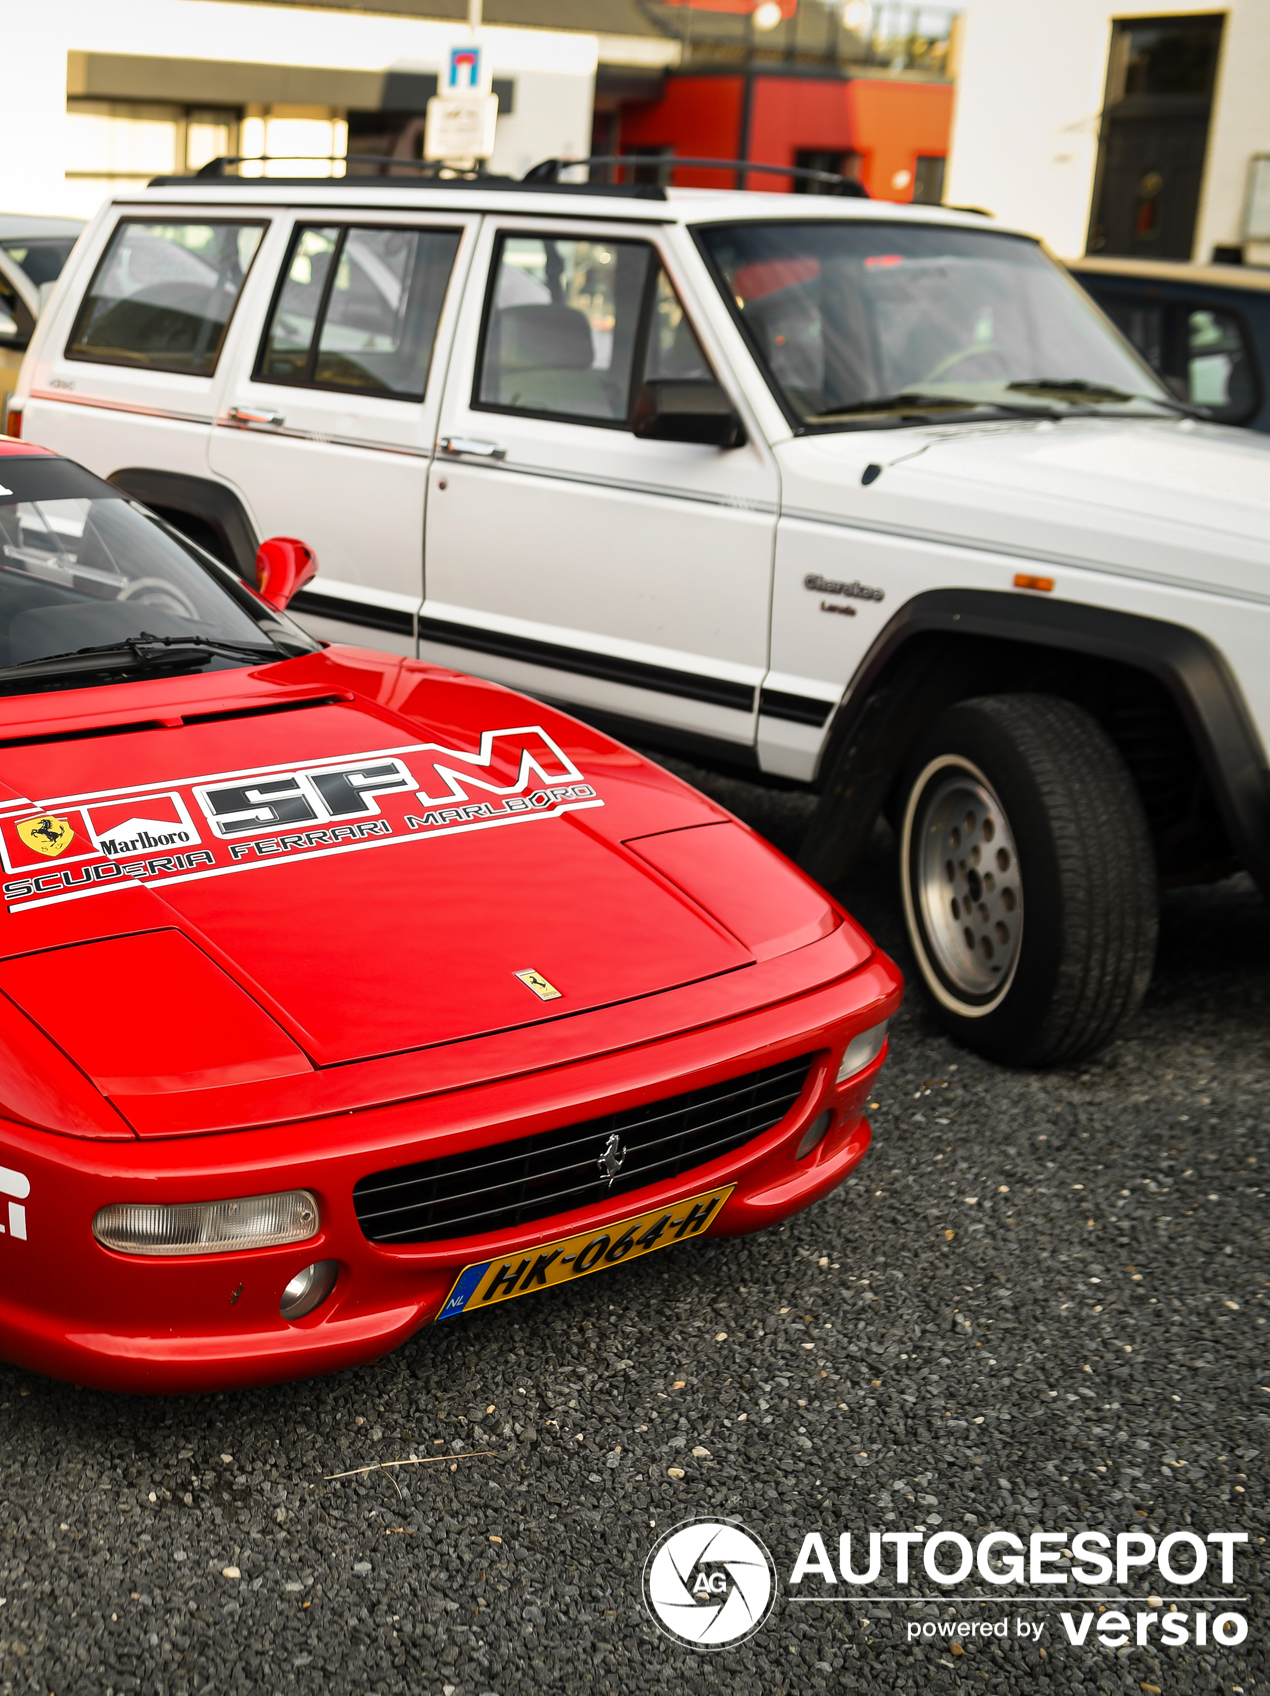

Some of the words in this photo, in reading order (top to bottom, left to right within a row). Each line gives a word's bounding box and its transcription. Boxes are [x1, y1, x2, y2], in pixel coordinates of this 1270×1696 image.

[2, 849, 217, 900] SCUDERIA
[227, 819, 394, 861] FERRARI
[404, 784, 597, 829] MARLBORO
[99, 830, 190, 857] Marlboro
[482, 1196, 722, 1301] HK-064-H
[446, 1294, 465, 1311] NL
